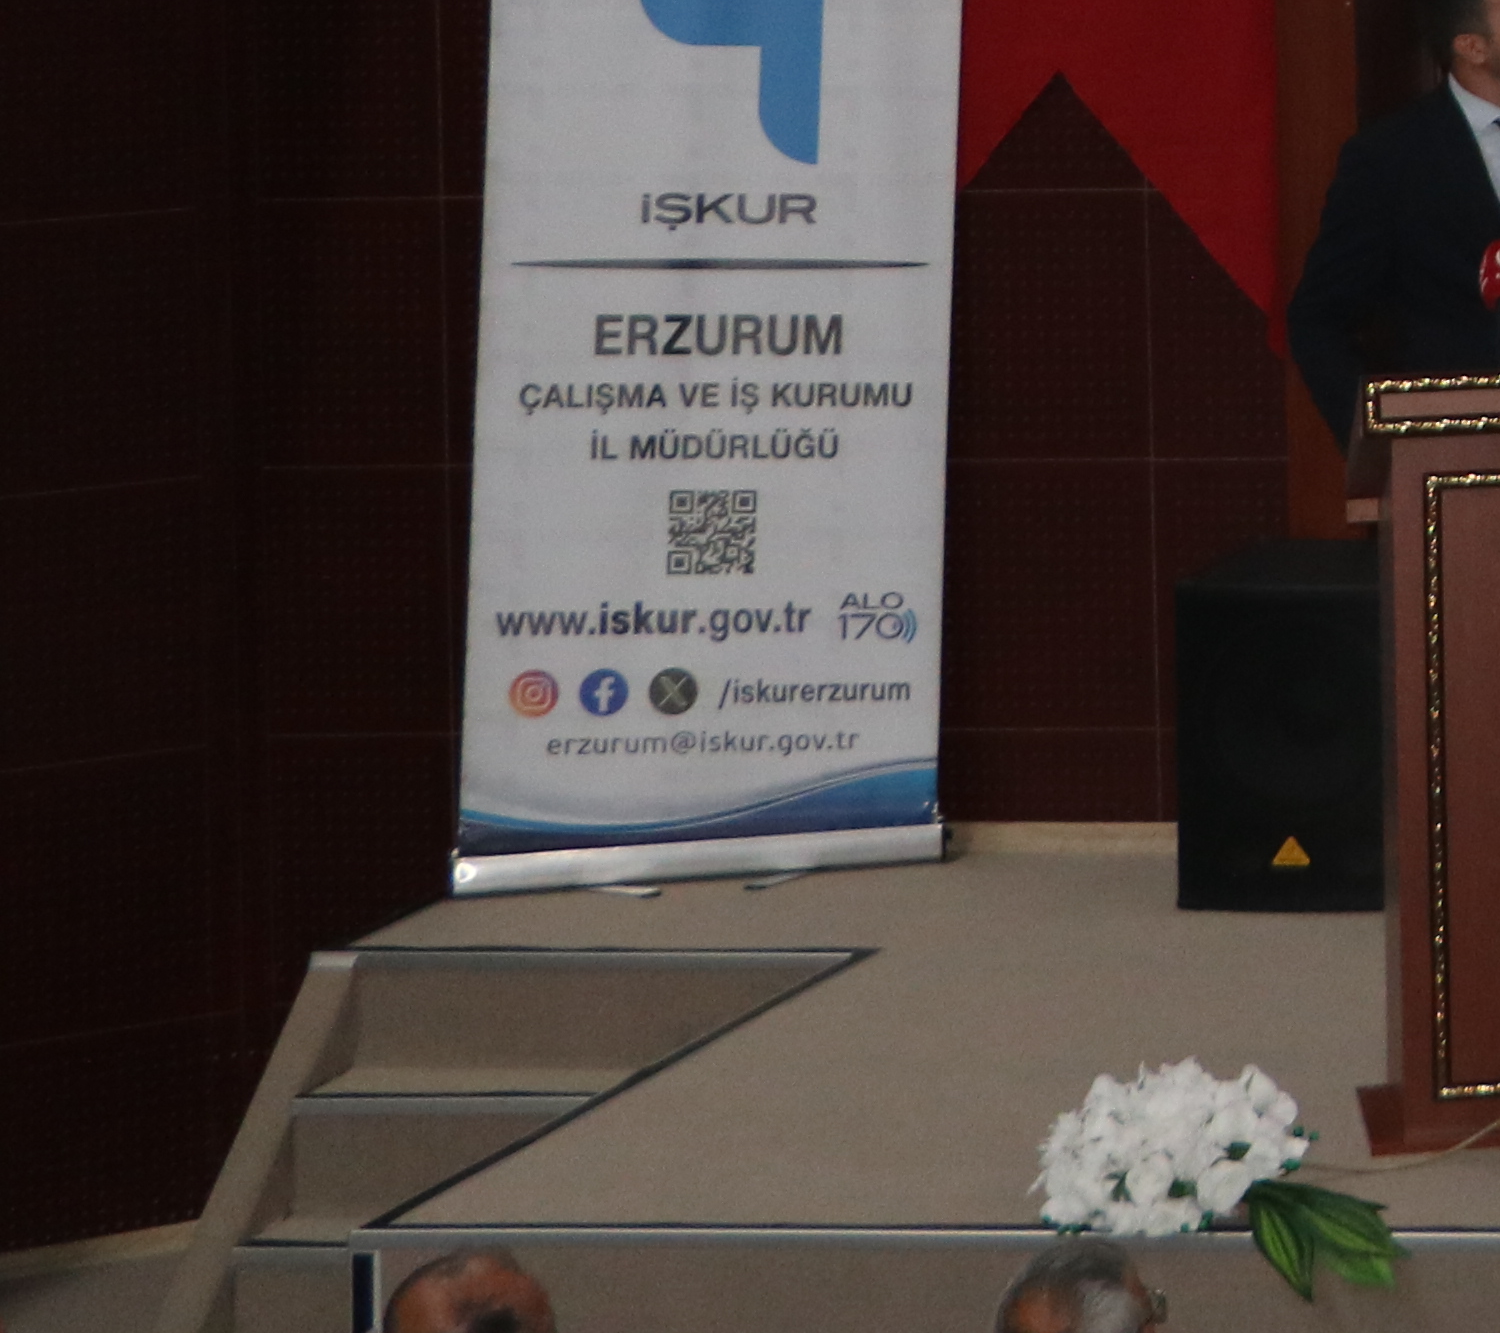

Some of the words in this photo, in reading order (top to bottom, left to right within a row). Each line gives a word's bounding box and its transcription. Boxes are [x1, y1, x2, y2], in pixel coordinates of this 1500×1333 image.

[592, 312, 844, 357] ERZURUM
[519, 381, 667, 416] ÇALIŞMA
[678, 381, 720, 408] VE
[730, 375, 760, 415] İŞ
[770, 381, 914, 409] KURUMU
[589, 428, 618, 461] İL
[628, 426, 840, 462] MÜDÜRLÜĞÜ
[839, 591, 904, 611] ALO
[495, 600, 812, 643] www.iskur.gov.tr
[837, 612, 905, 641] 170
[717, 677, 912, 711] /iskurerzurum
[545, 727, 861, 757] erzurum@iskur.gov.tr
